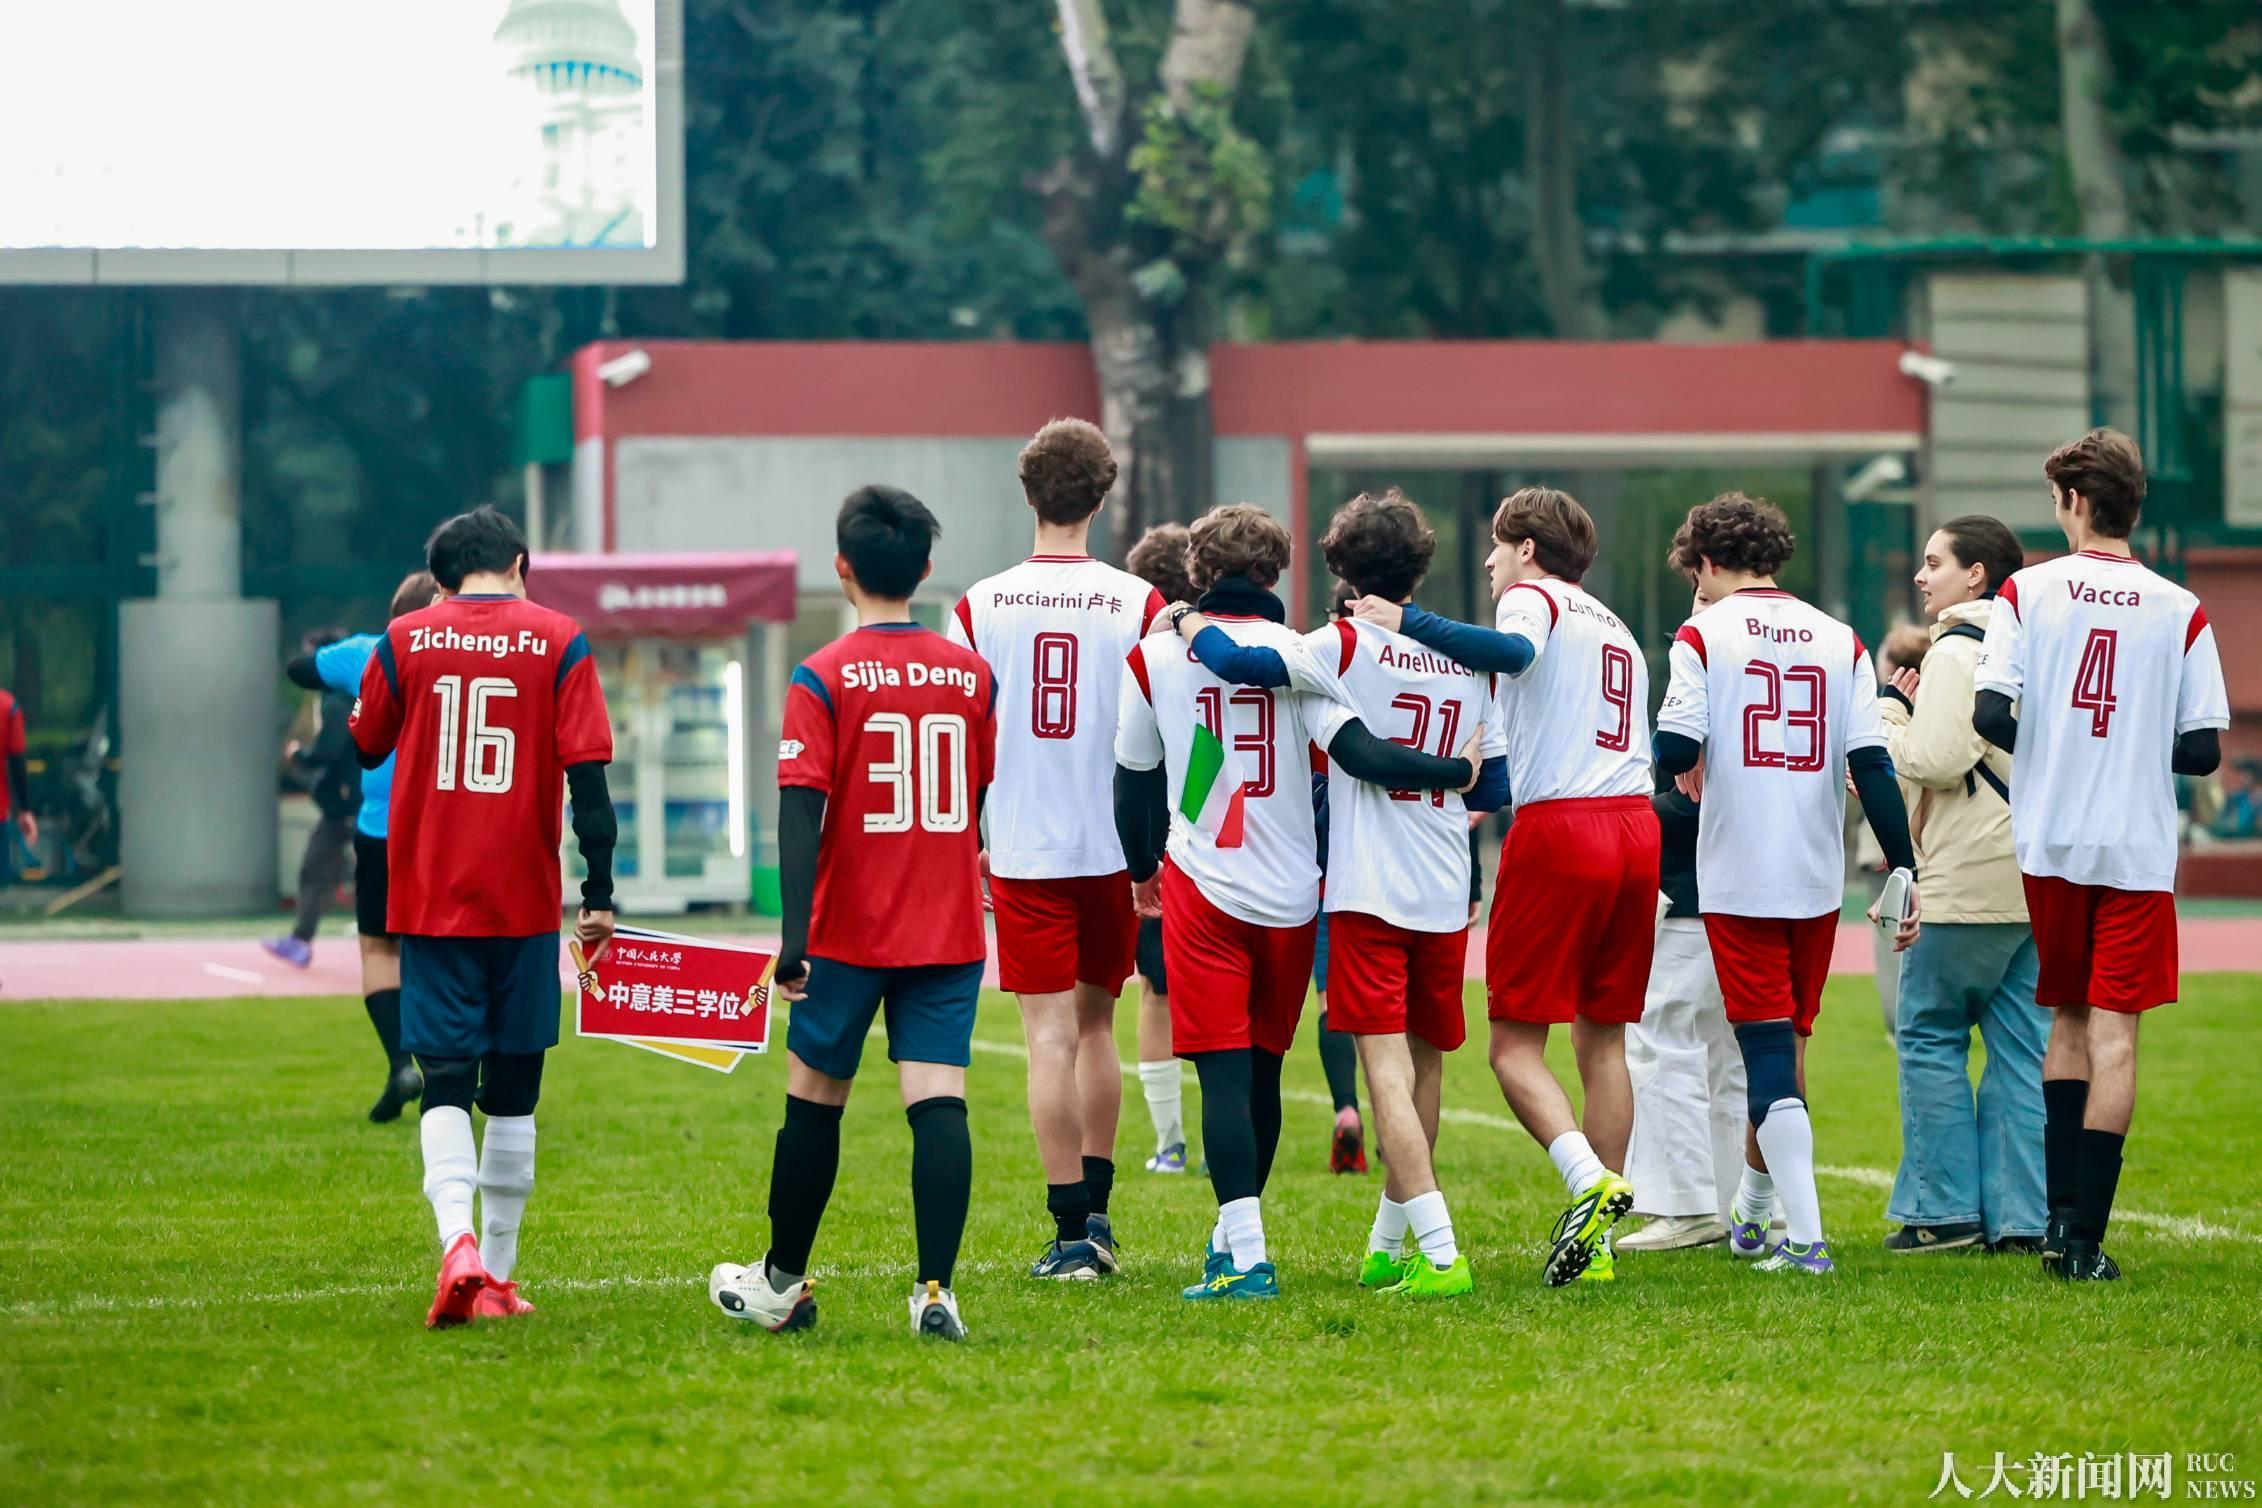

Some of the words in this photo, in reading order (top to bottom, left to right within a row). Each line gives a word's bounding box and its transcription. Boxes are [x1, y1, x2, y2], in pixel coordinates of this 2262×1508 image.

[409, 626, 547, 658] Zicheng.Fu
[994, 591, 1083, 609] Pucciarini
[1087, 592, 1122, 614] 卢卡
[1746, 618, 1813, 643] Bruno
[2067, 580, 2140, 607] Vacca
[841, 660, 900, 692] Sijia
[906, 662, 977, 697] Deng
[1032, 632, 1078, 739] 8
[1596, 643, 1632, 752] 9
[1743, 659, 1827, 772] 23
[2071, 628, 2117, 738] 4
[433, 675, 518, 793] 16
[864, 712, 969, 833] 30
[1196, 687, 1275, 798] 13
[1386, 692, 1462, 808] 21
[608, 981, 741, 1020] 中意美三学位
